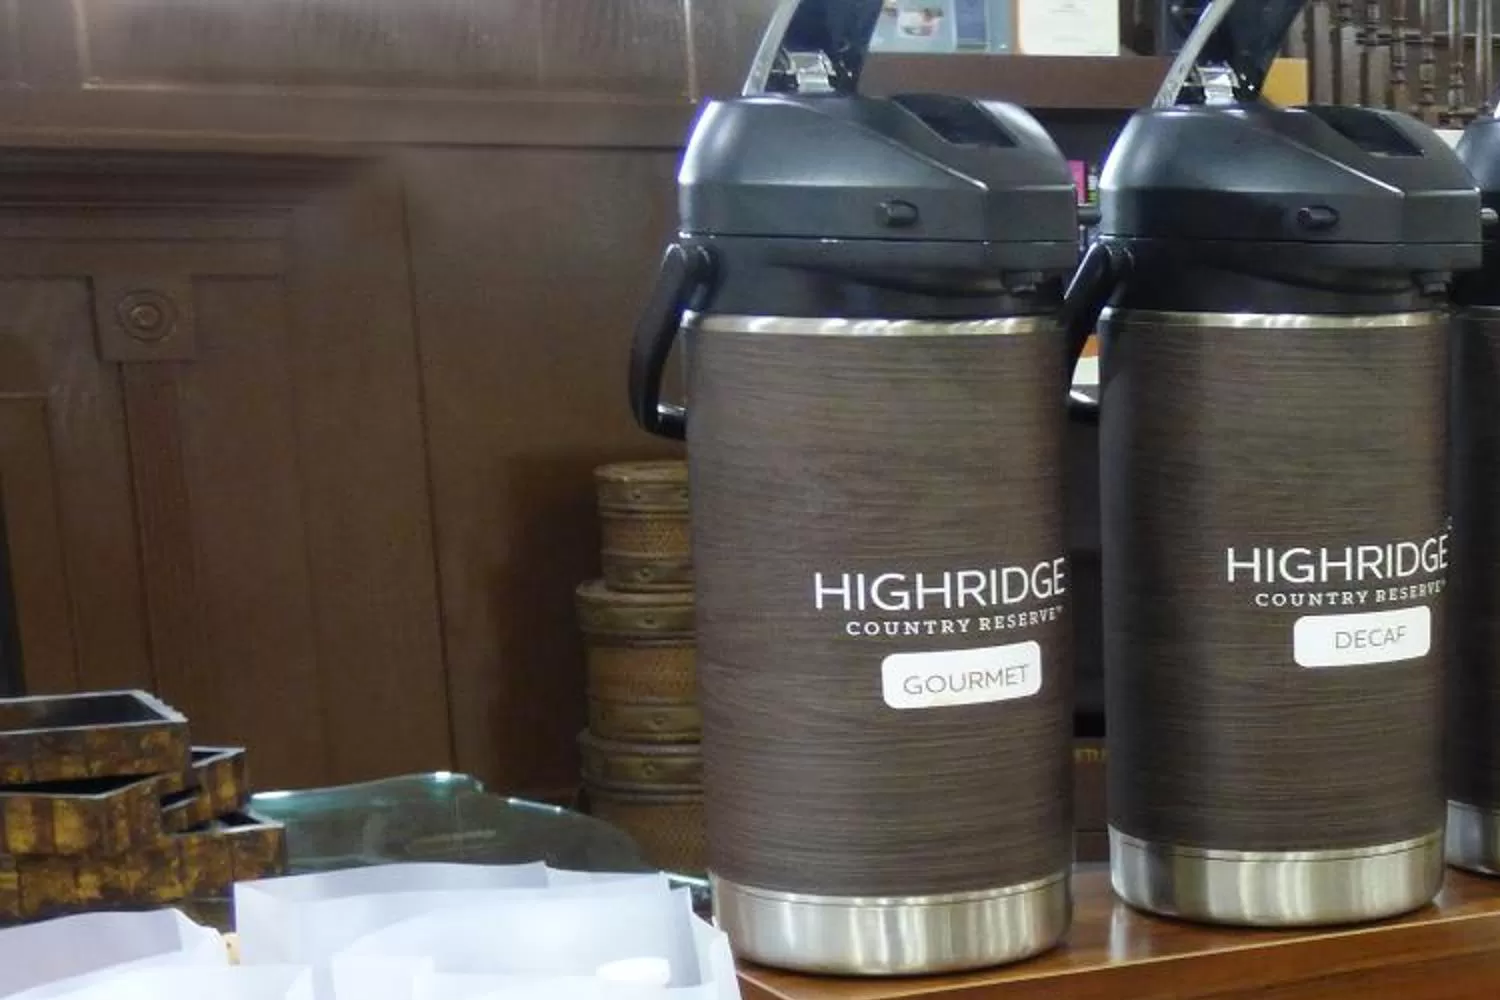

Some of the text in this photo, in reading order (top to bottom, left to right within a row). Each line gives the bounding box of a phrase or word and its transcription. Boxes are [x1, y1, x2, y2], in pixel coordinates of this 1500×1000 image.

[1227, 534, 1448, 583] HIGHRIDGE
[814, 557, 1066, 611] HIGHRIDGE
[1254, 579, 1440, 607] COUNTRY RESERVE
[846, 606, 1056, 636] COUNTRY RESERVE
[1335, 625, 1408, 649] DECAF
[903, 664, 1030, 695] GOURMET
